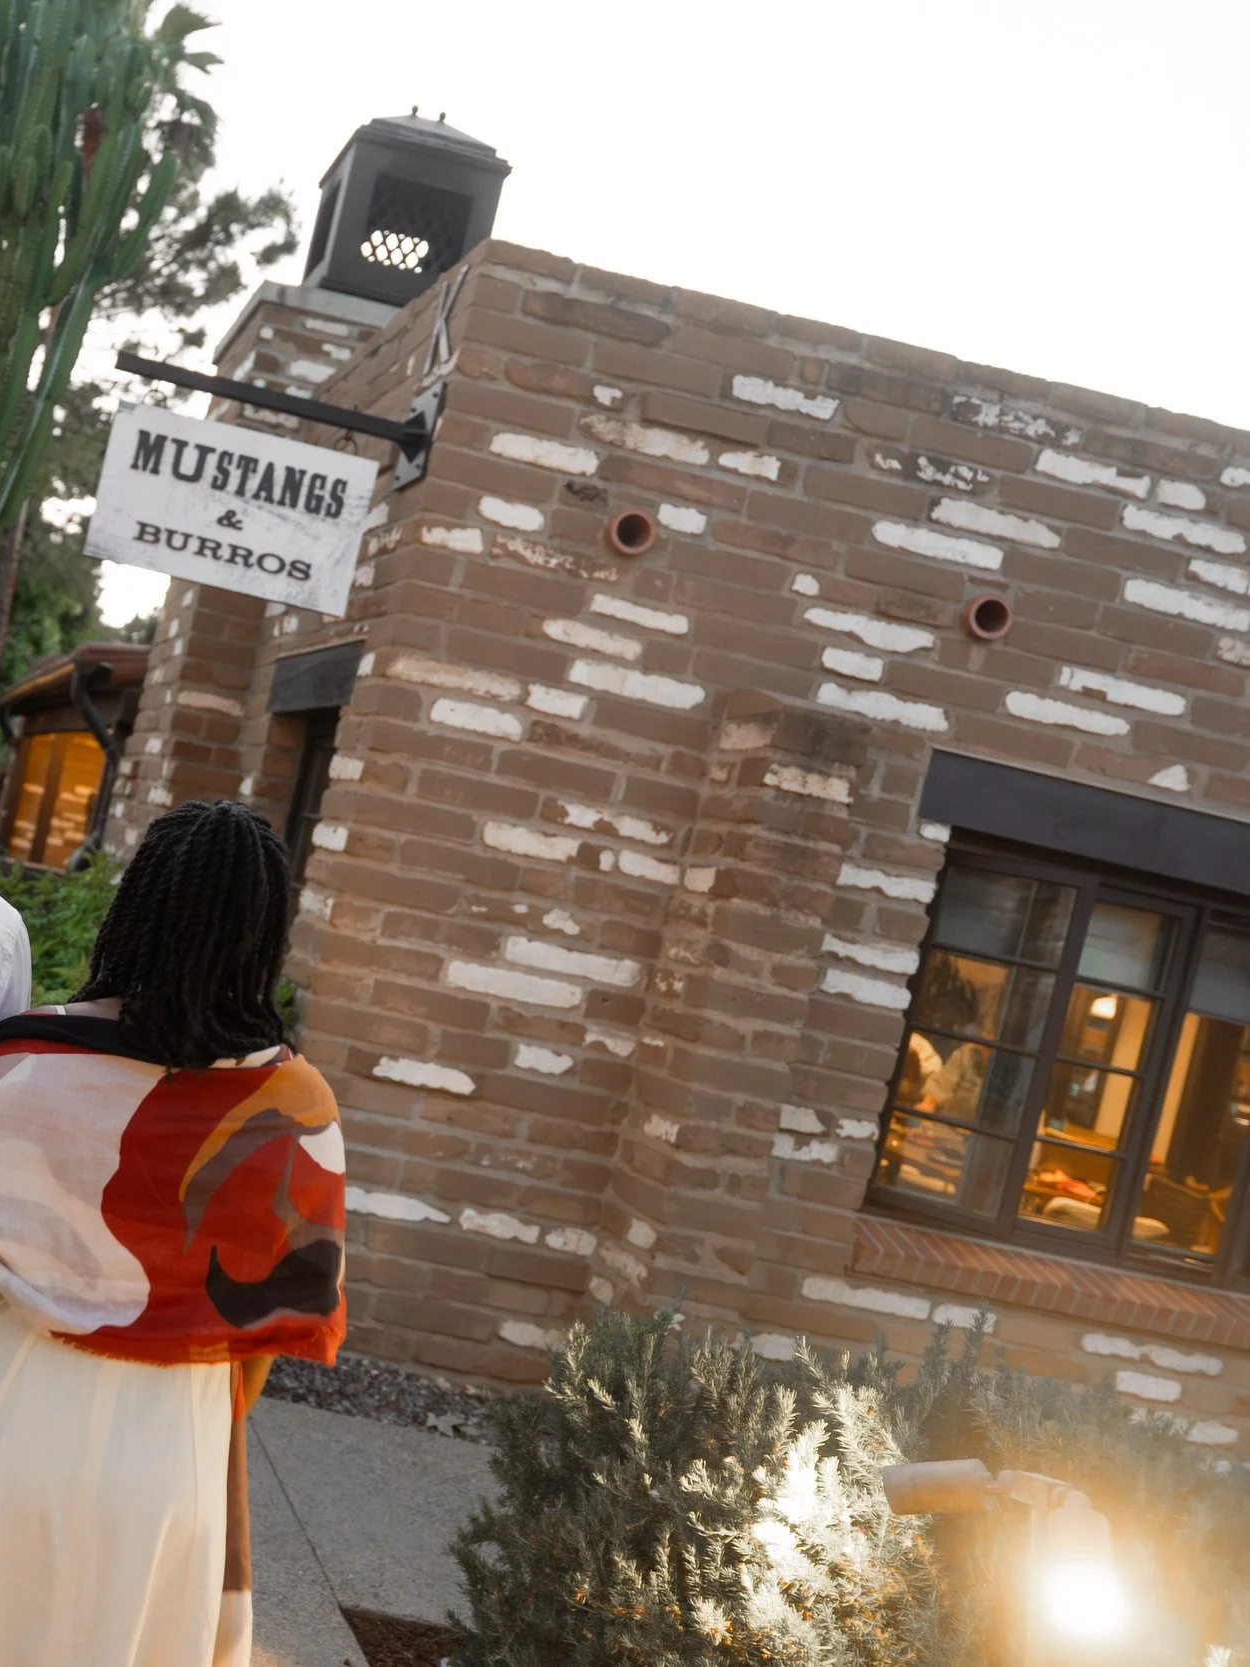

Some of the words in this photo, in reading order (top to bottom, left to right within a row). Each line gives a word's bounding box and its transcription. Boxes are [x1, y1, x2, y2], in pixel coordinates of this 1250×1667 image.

[130, 429, 348, 519] MUSTANGS
[216, 509, 243, 531] &
[133, 521, 312, 581] BURROS
